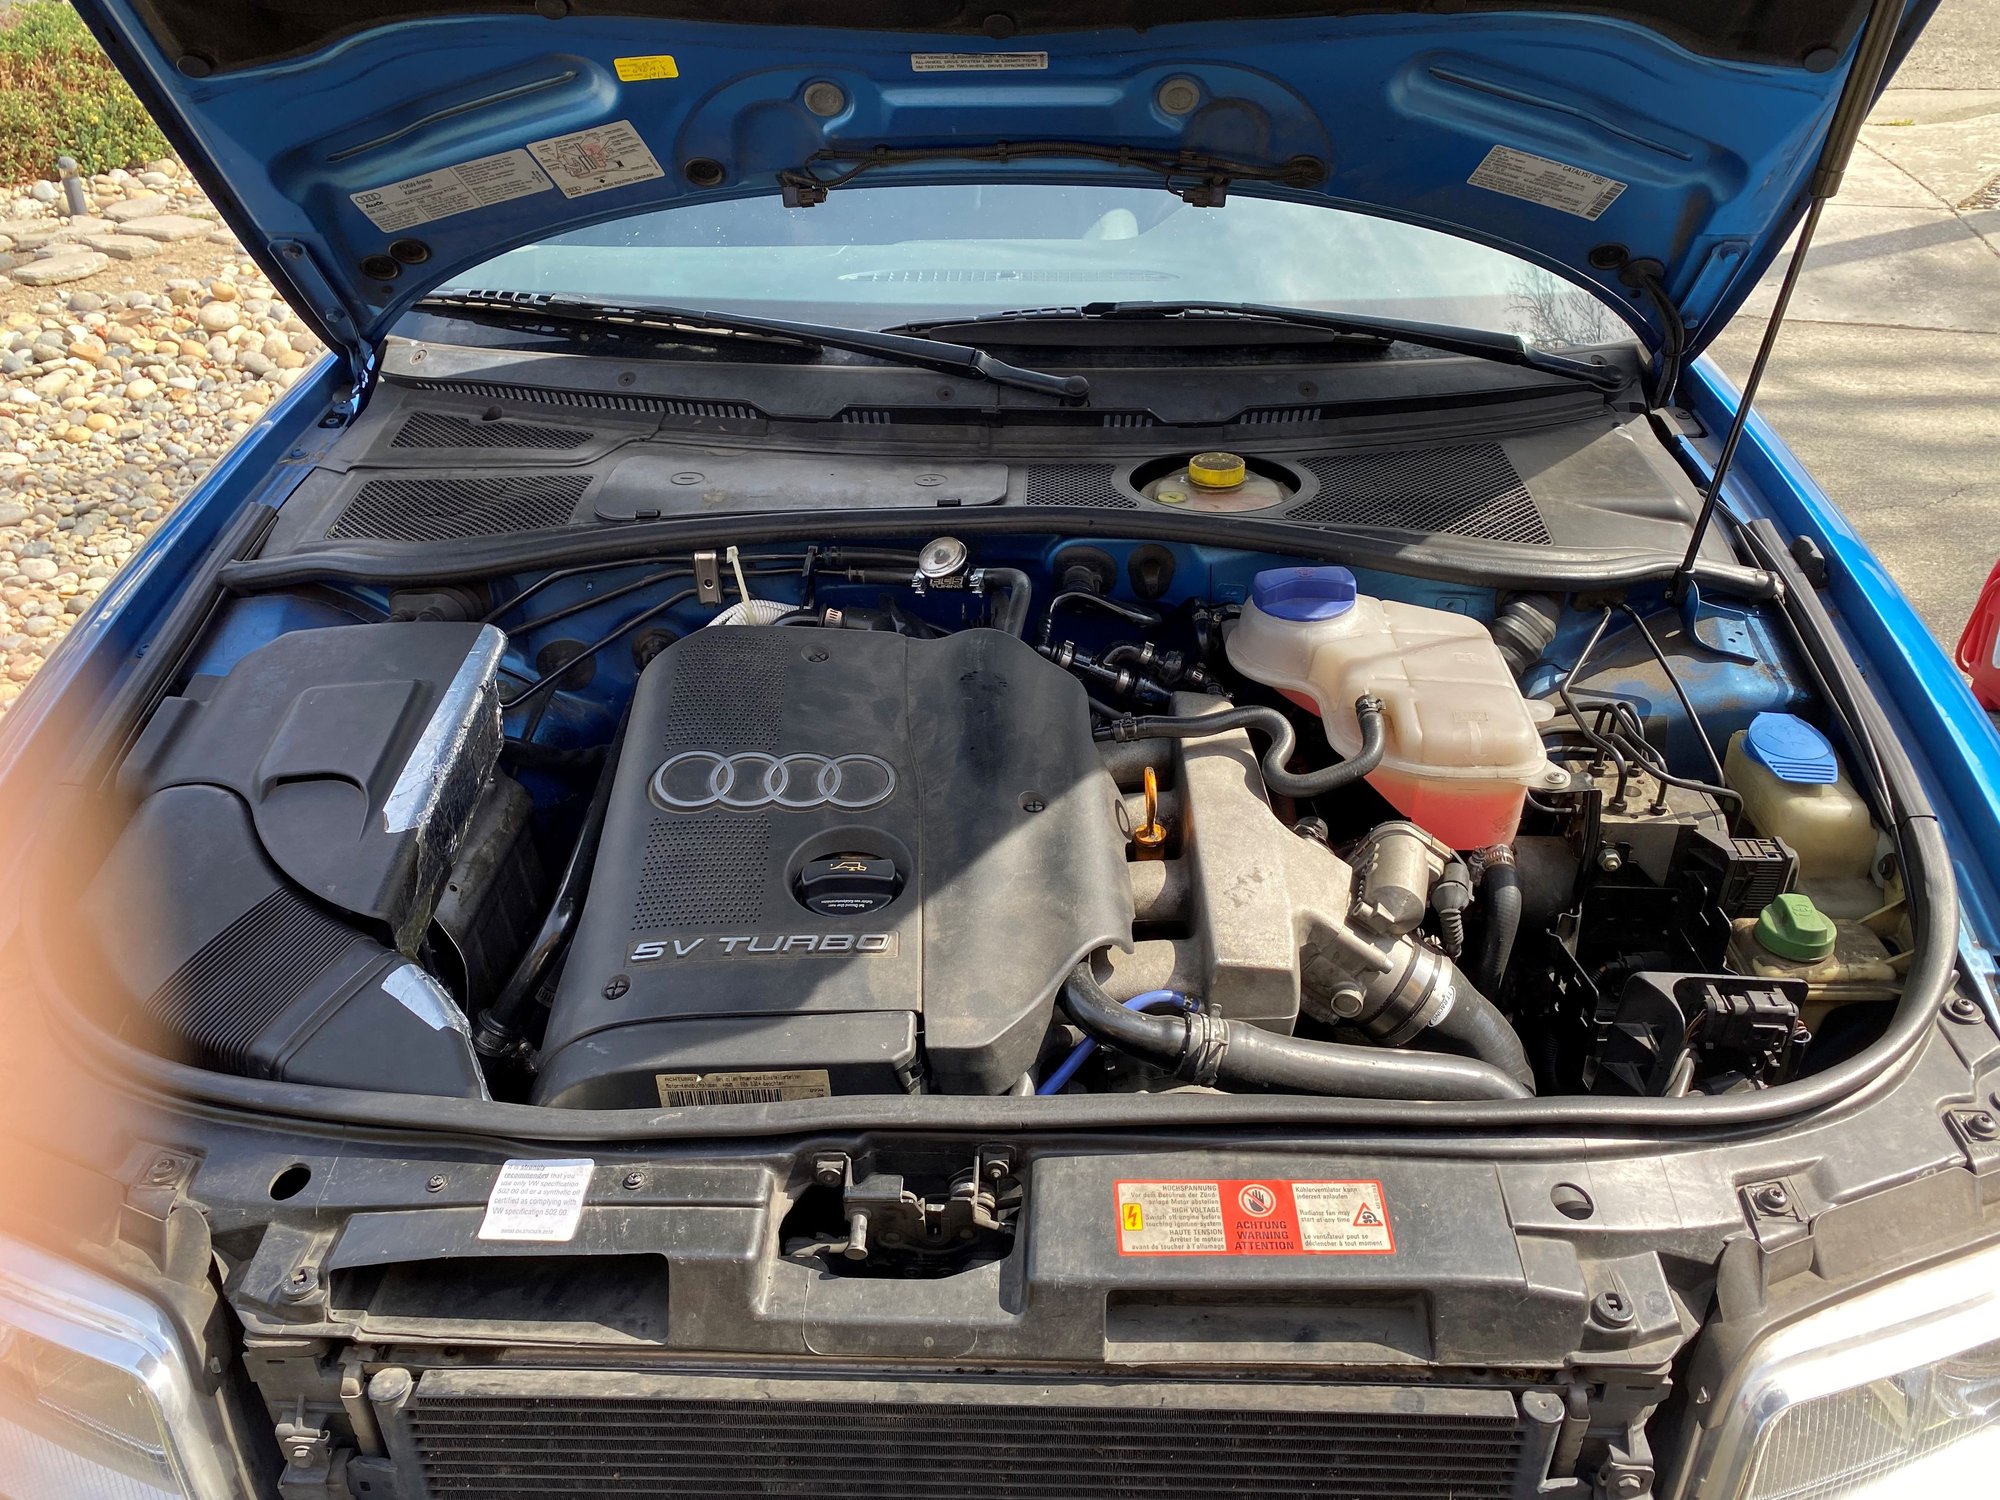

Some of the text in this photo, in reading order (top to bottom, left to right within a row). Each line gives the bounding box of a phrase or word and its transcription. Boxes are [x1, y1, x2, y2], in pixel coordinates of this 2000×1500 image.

[1562, 166, 1592, 179] CATALYST
[630, 934, 892, 962] 5V TURBO
[1236, 1221, 1287, 1230] ACHTUNG
[1237, 1231, 1289, 1240] WARNING
[1235, 1242, 1294, 1250] ATTENTION
